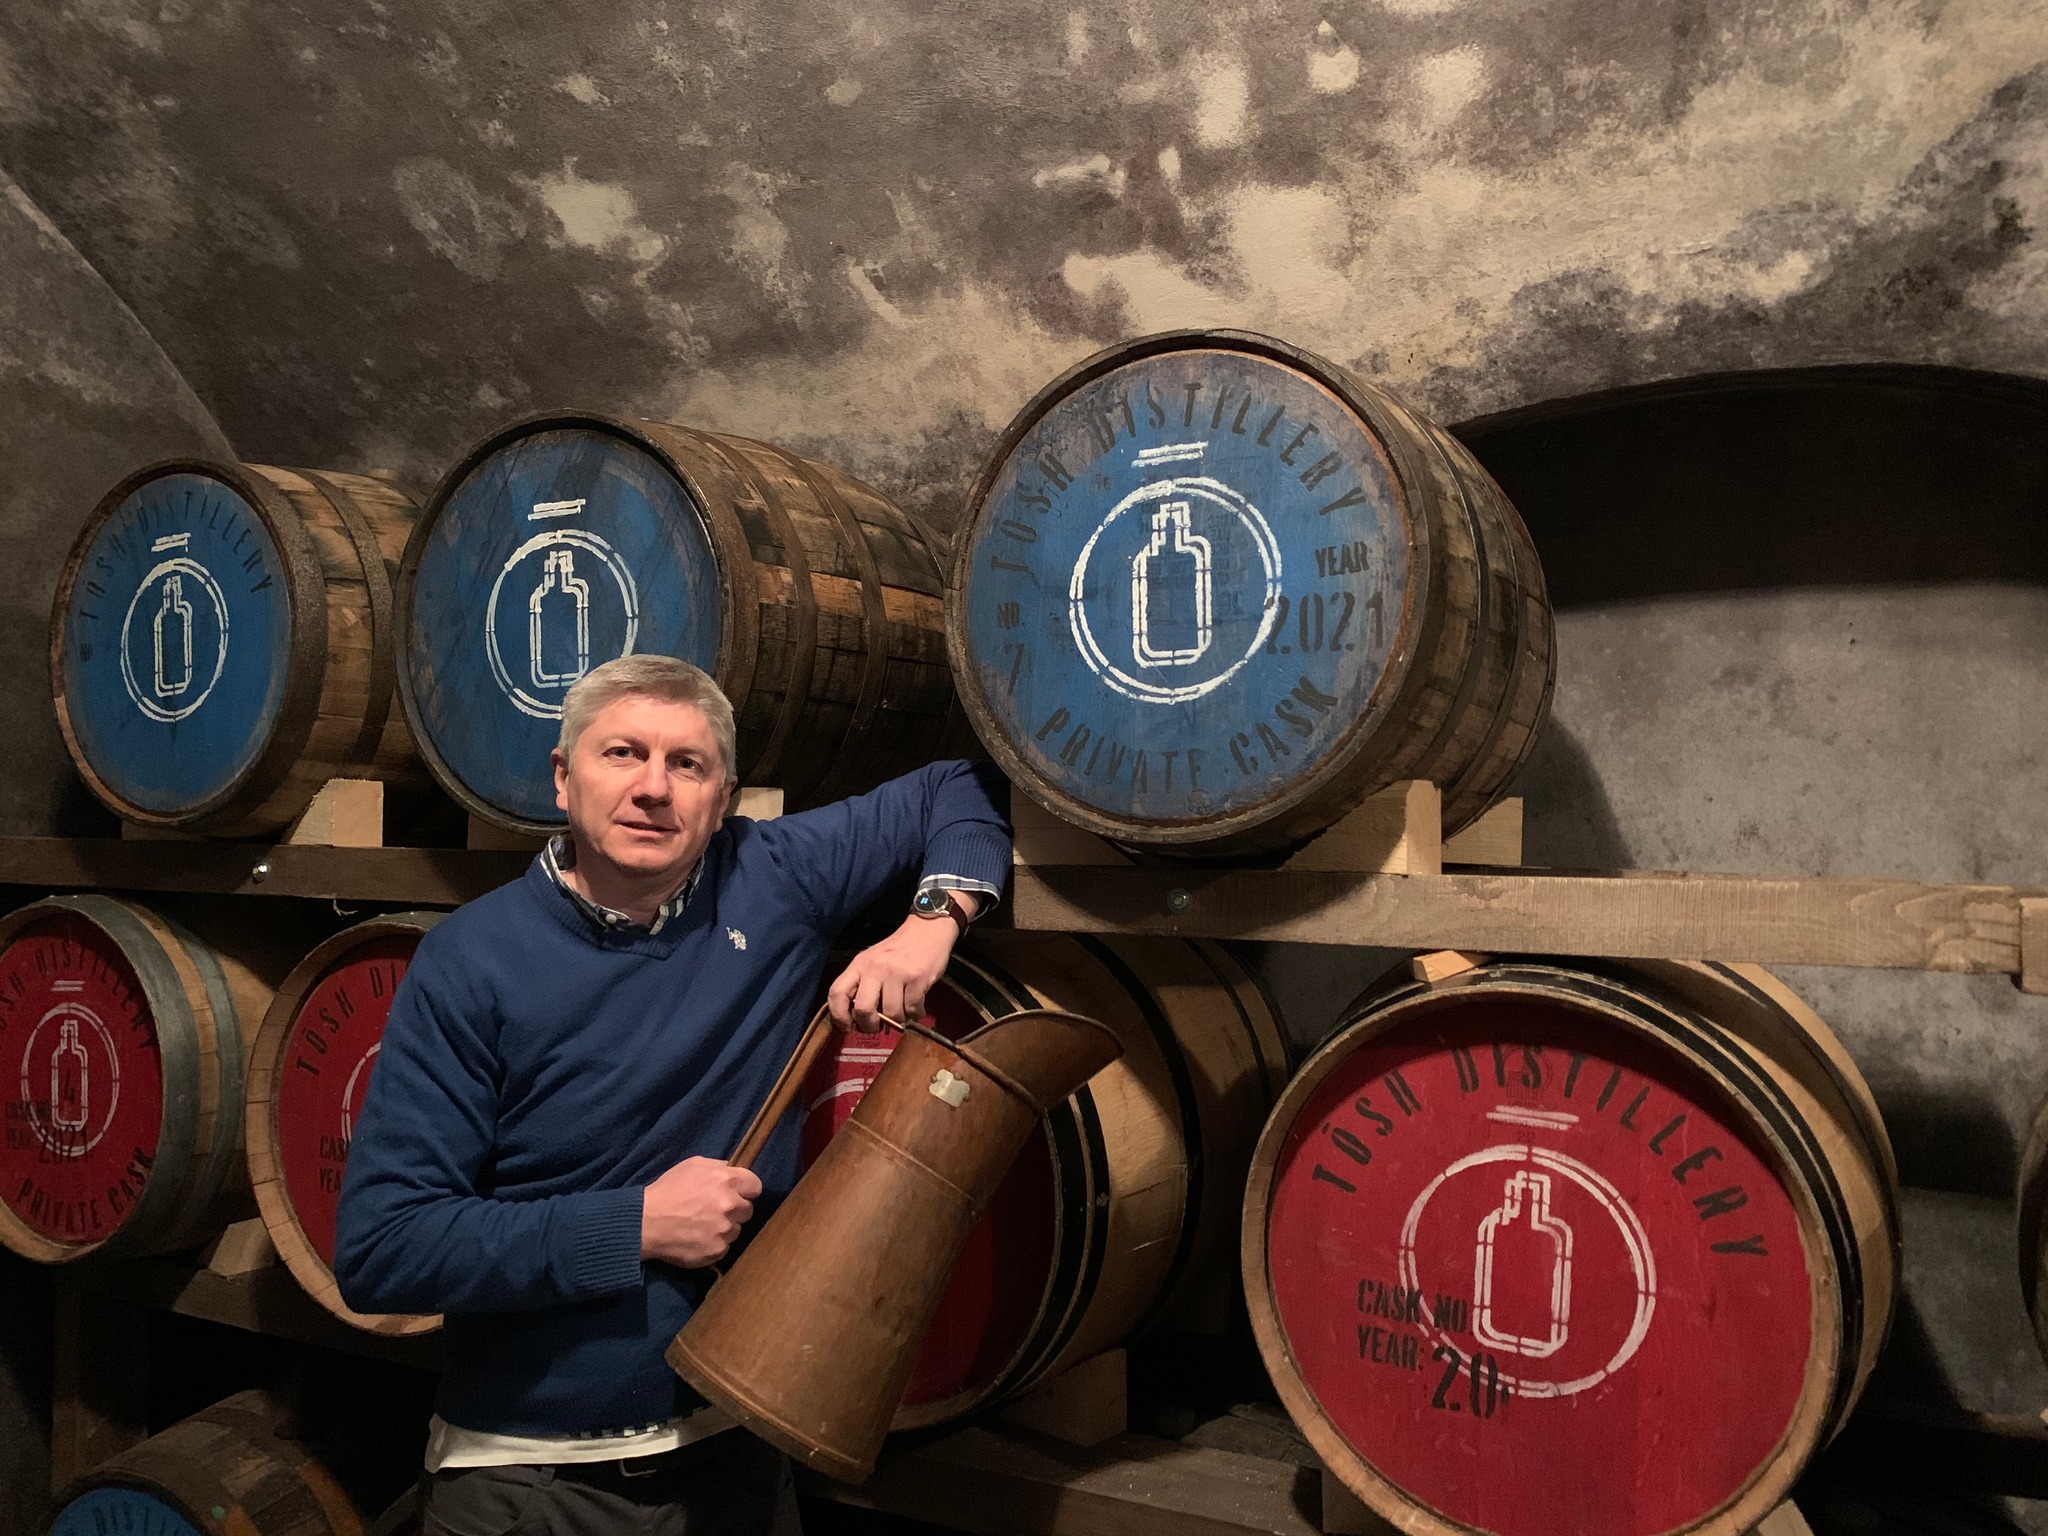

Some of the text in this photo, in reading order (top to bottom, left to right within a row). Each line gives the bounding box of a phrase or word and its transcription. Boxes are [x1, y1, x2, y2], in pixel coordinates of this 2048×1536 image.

[1089, 382, 1367, 517] DISTILLERY
[136, 490, 273, 594] DISTILLERY
[1314, 541, 1370, 577] YEAR
[1264, 590, 1384, 655] 2021
[1036, 675, 1338, 793] PRIVATE CASK
[1452, 1040, 1768, 1259] DISTILLERY
[16, 1177, 102, 1233] PRIVATE
[1357, 1279, 1422, 1323] CASK
